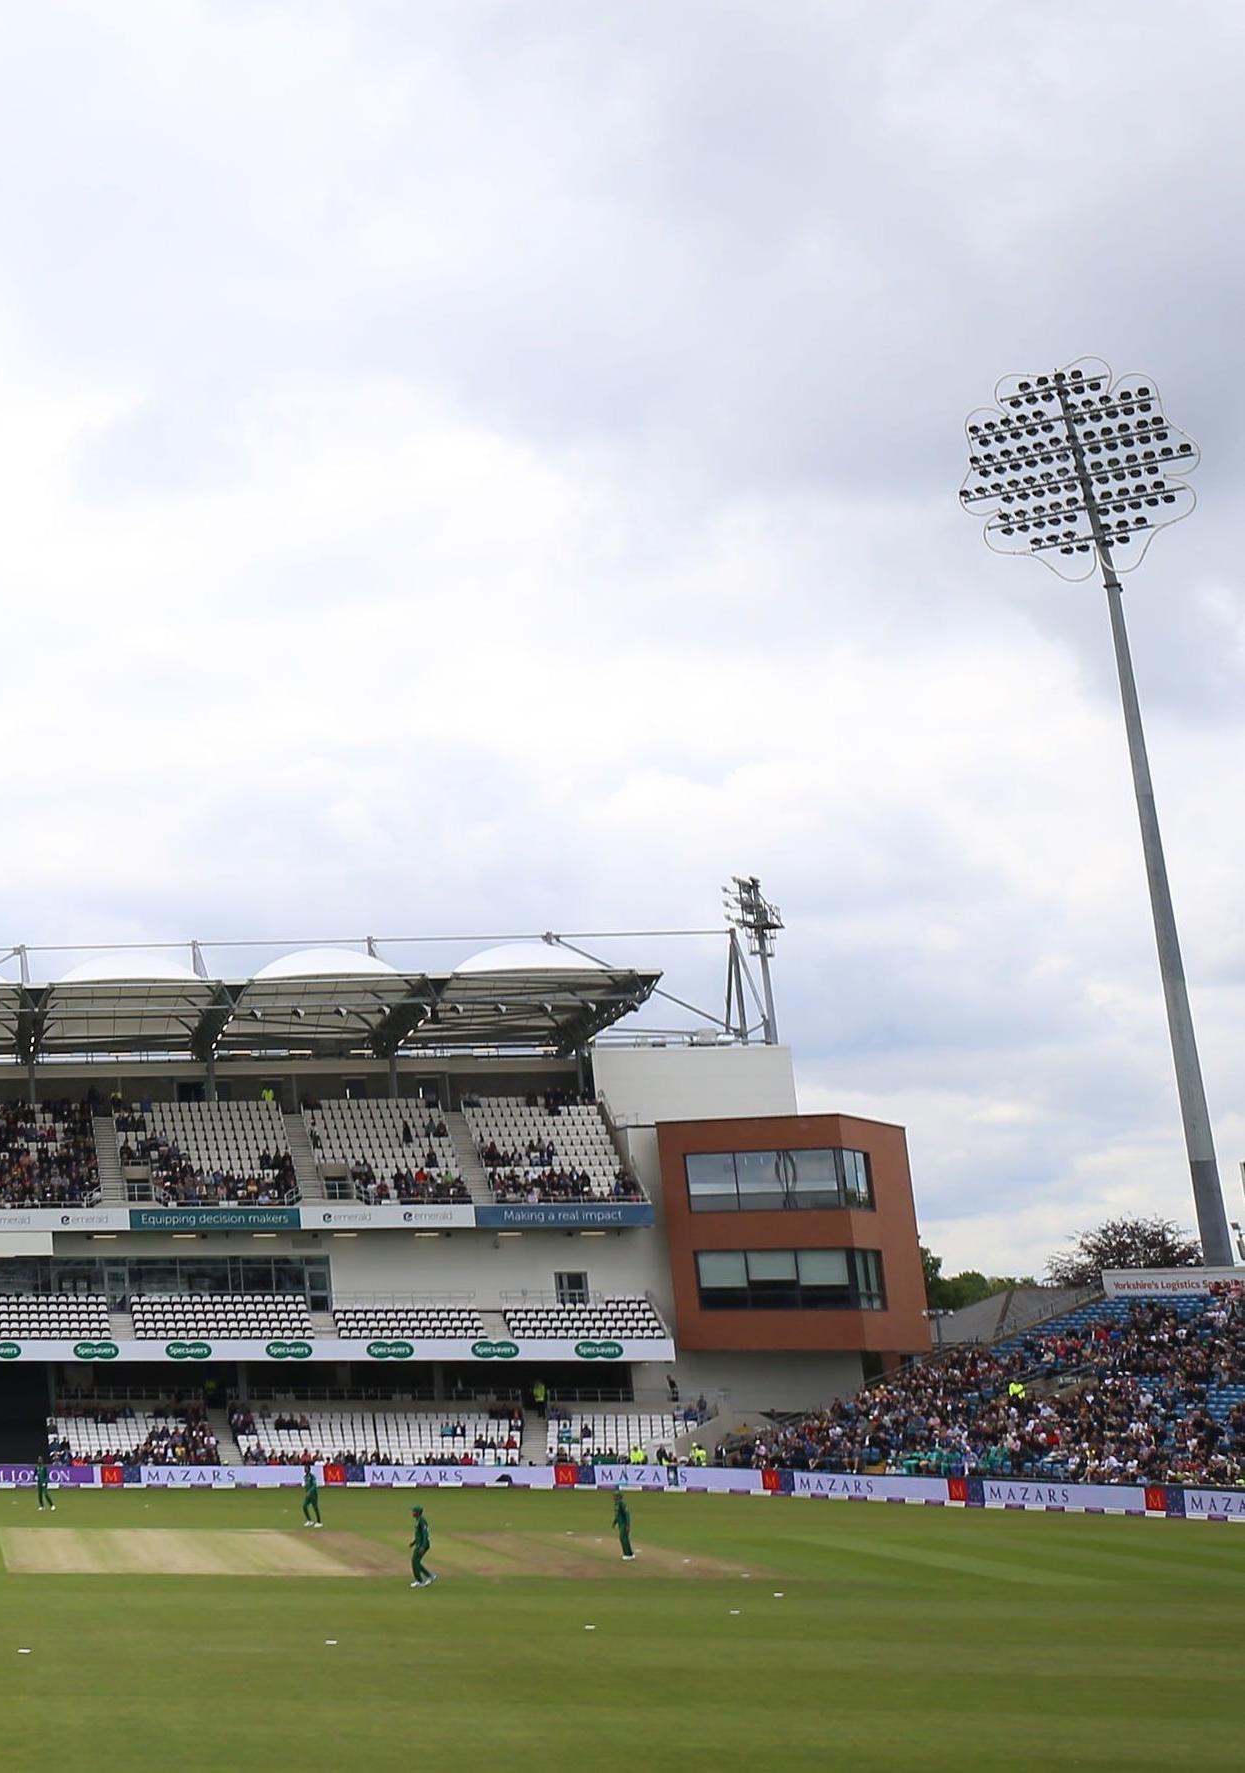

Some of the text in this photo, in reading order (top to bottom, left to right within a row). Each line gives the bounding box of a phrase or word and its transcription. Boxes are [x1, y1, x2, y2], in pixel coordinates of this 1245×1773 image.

[141, 1213, 289, 1226] Equipping decision makers
[504, 1210, 623, 1223] Making a real impact
[1113, 1280, 1158, 1290] Yorkshire's
[1161, 1280, 1200, 1292] Logistics
[76, 1345, 116, 1355] Specsavers
[169, 1344, 208, 1355] Specsavers
[269, 1344, 309, 1354] Specsavers
[369, 1344, 410, 1354] Specsavers
[475, 1344, 516, 1355] Specsavers
[578, 1344, 620, 1354] Specsavers
[147, 1471, 236, 1483] MAZARS
[371, 1470, 463, 1483] MAZARS
[601, 1471, 688, 1484] MAZAS
[799, 1477, 874, 1495] MAZARS
[989, 1487, 1070, 1505] MAZARS
